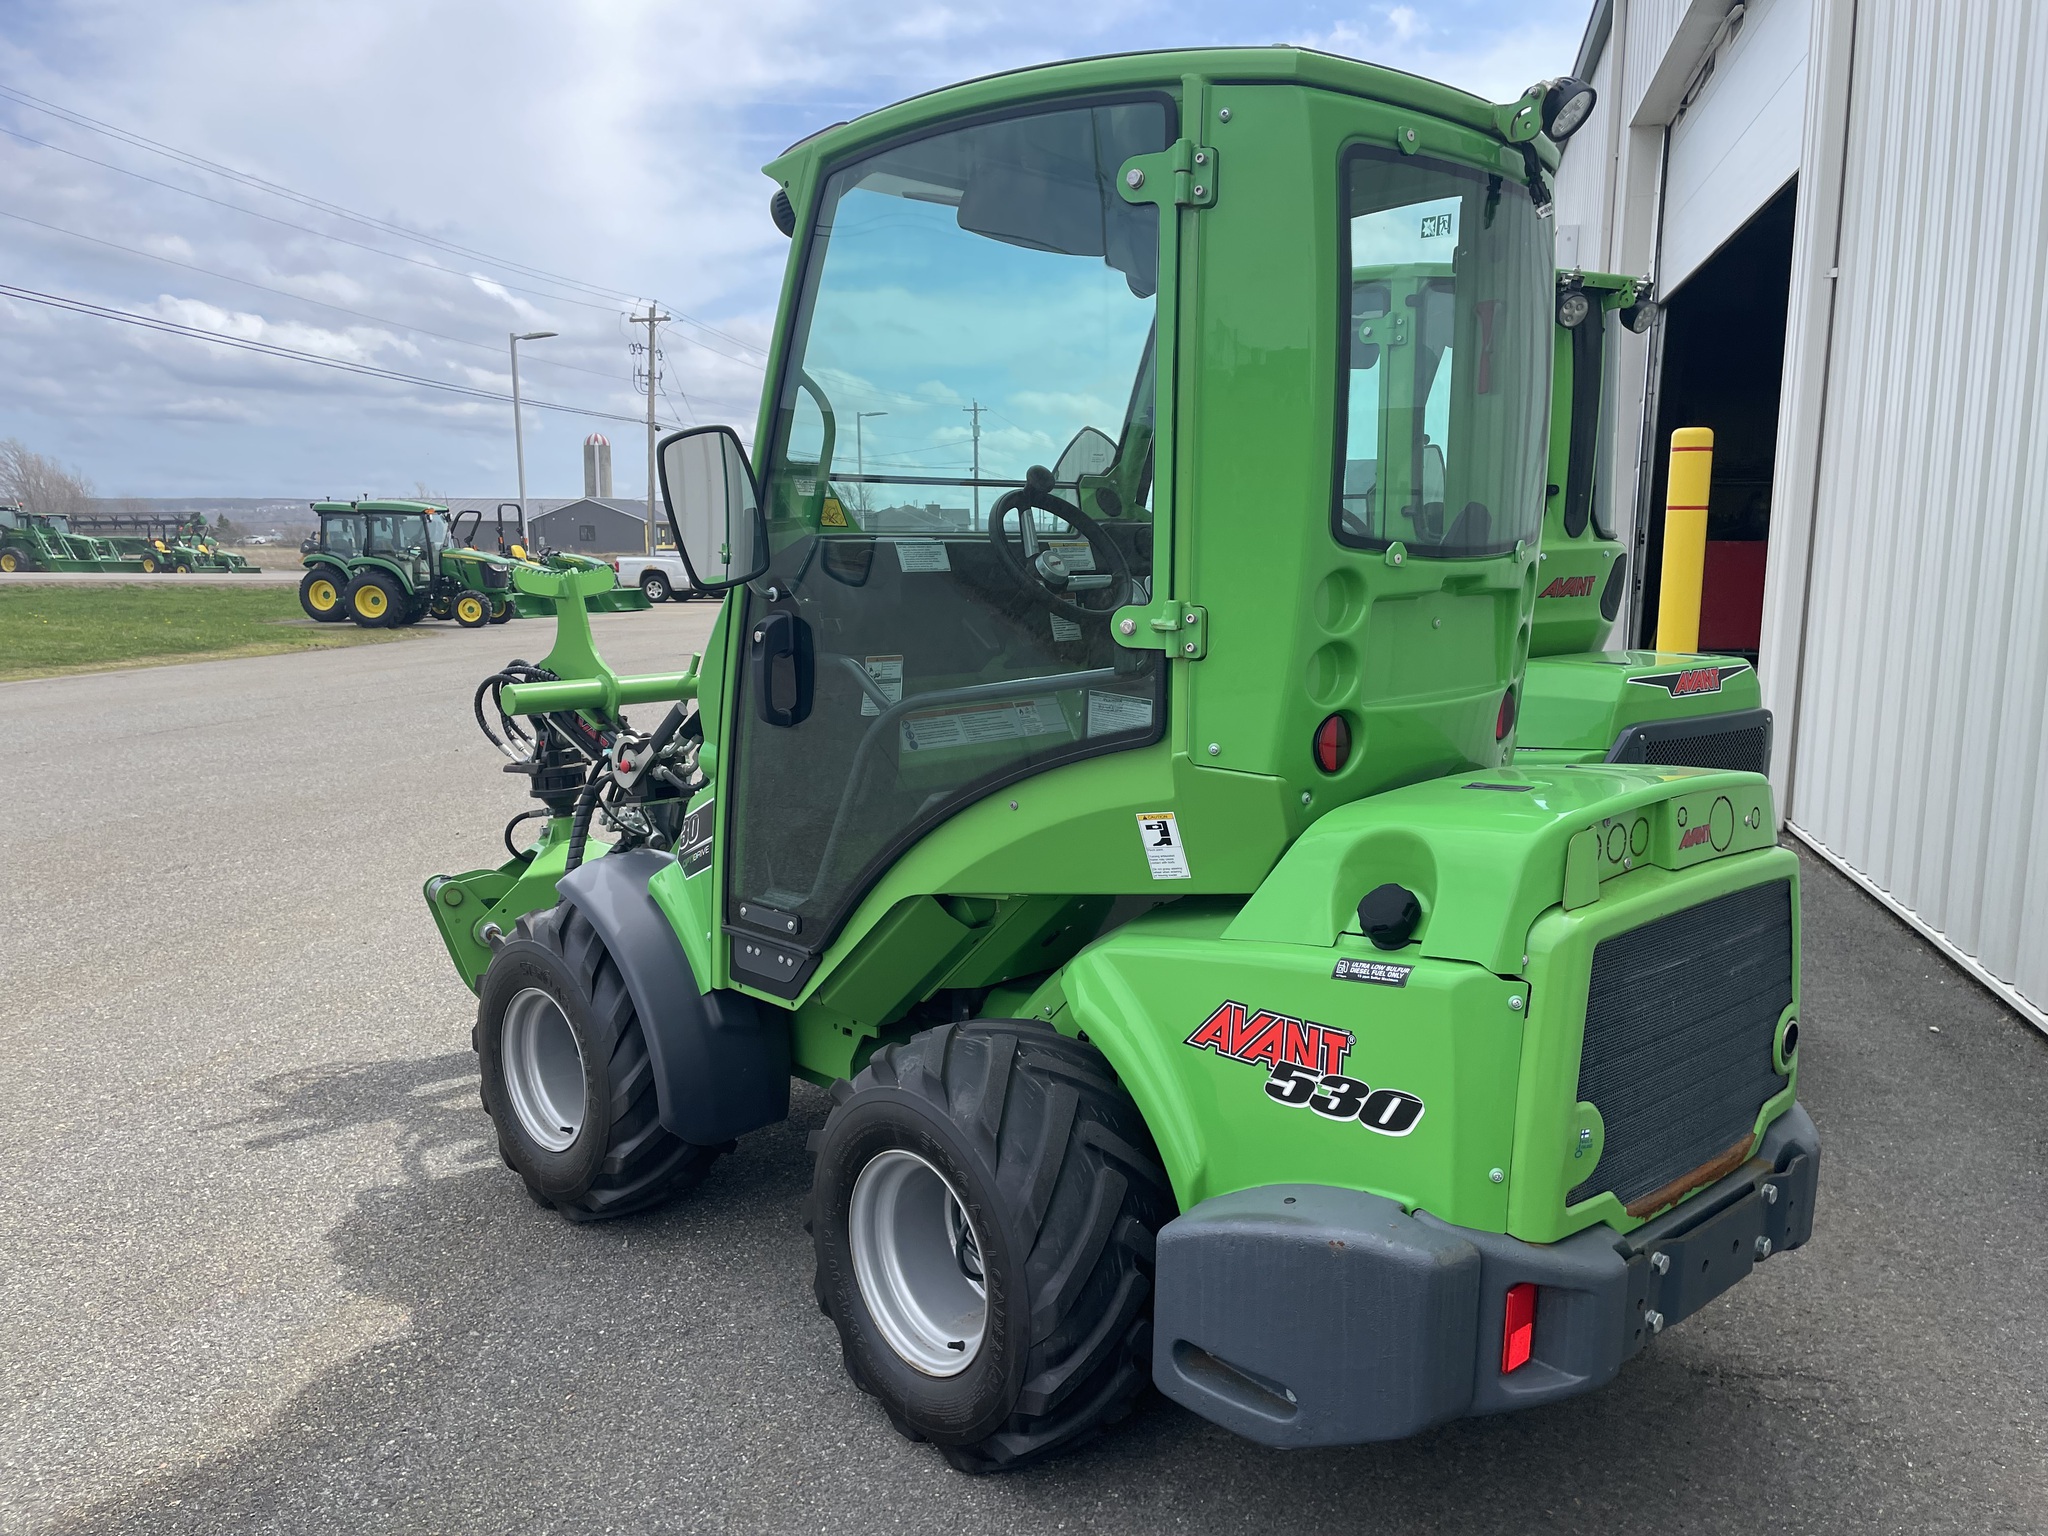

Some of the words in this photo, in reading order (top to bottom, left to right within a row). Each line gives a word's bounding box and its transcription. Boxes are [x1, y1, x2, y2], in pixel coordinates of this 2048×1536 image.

[1538, 575, 1597, 598] AVANT
[1673, 667, 1720, 696] AVANT
[1678, 823, 1711, 851] AVANT
[1350, 967, 1370, 975] DIESEL
[1370, 969, 1386, 977] FUEL
[1386, 971, 1405, 979] ONLY
[1352, 961, 1371, 969] ULTRA
[1371, 963, 1387, 971] LOW
[1385, 965, 1411, 974] SULFUR
[1264, 1058, 1425, 1137] 530
